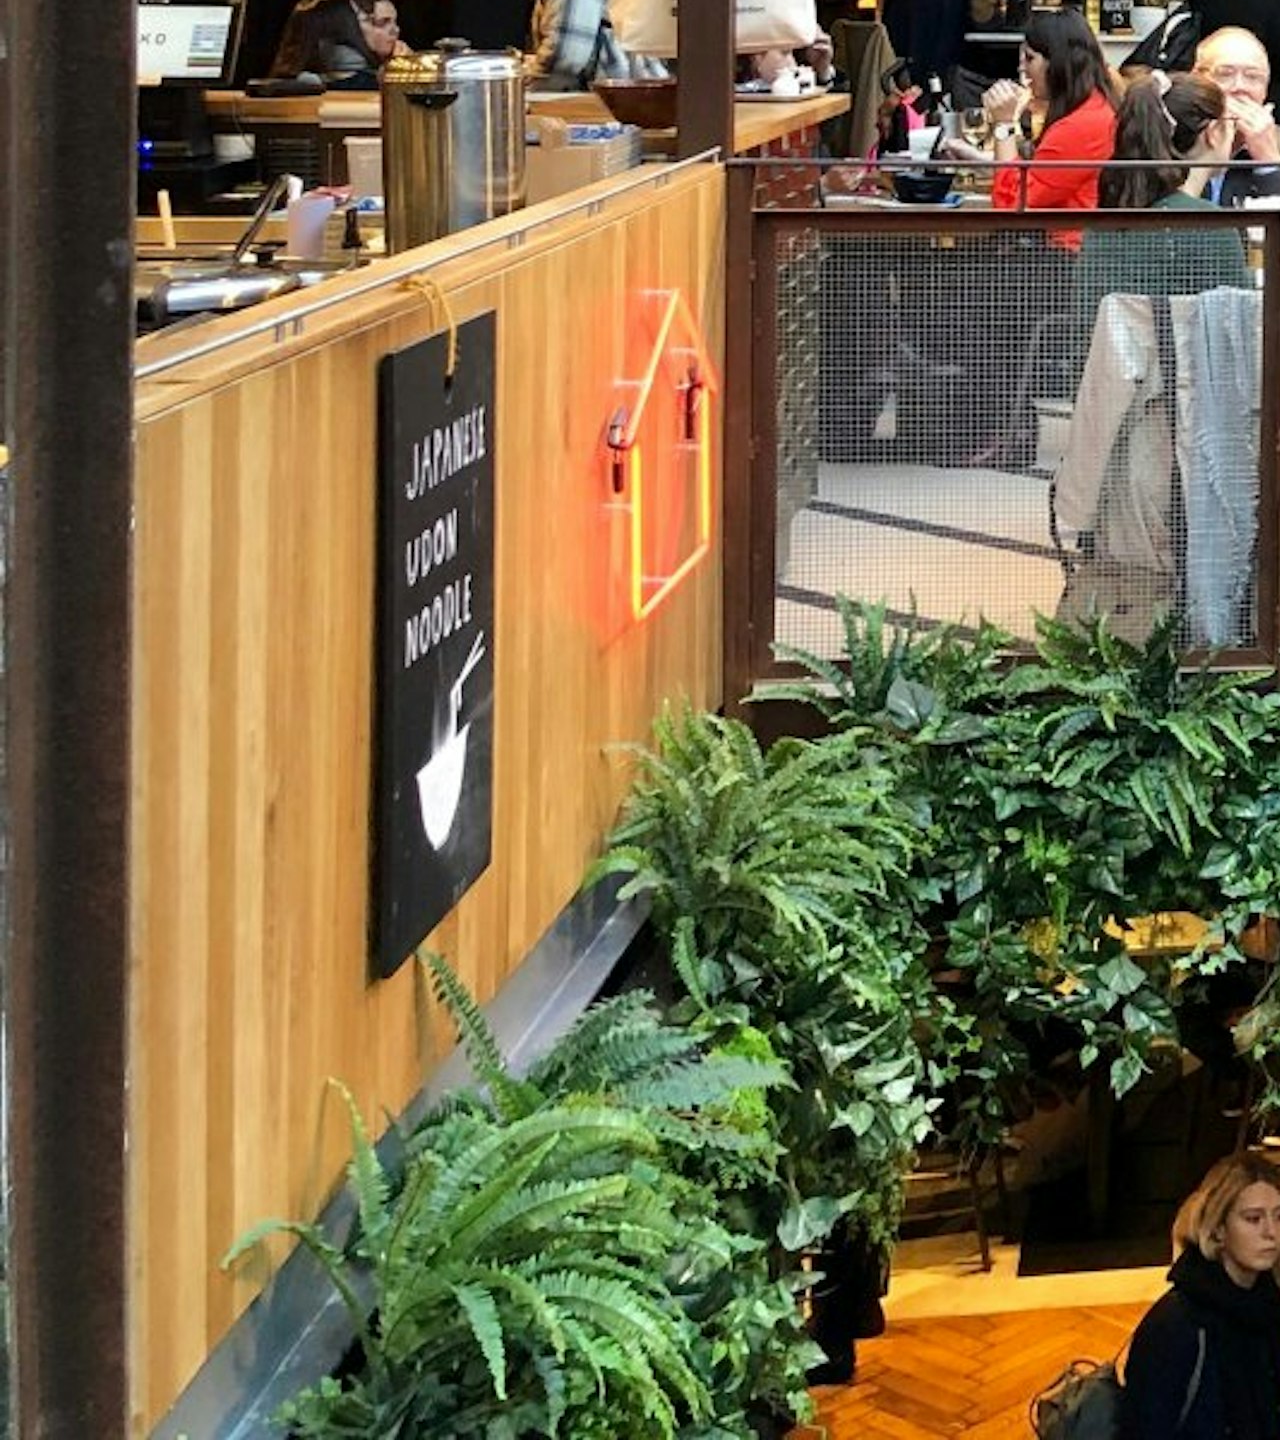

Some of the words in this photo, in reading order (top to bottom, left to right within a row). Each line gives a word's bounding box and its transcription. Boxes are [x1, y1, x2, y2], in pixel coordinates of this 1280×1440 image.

[405, 405, 487, 501] JAPANESE
[406, 507, 459, 588] UDON
[404, 573, 473, 669] NOODLE
